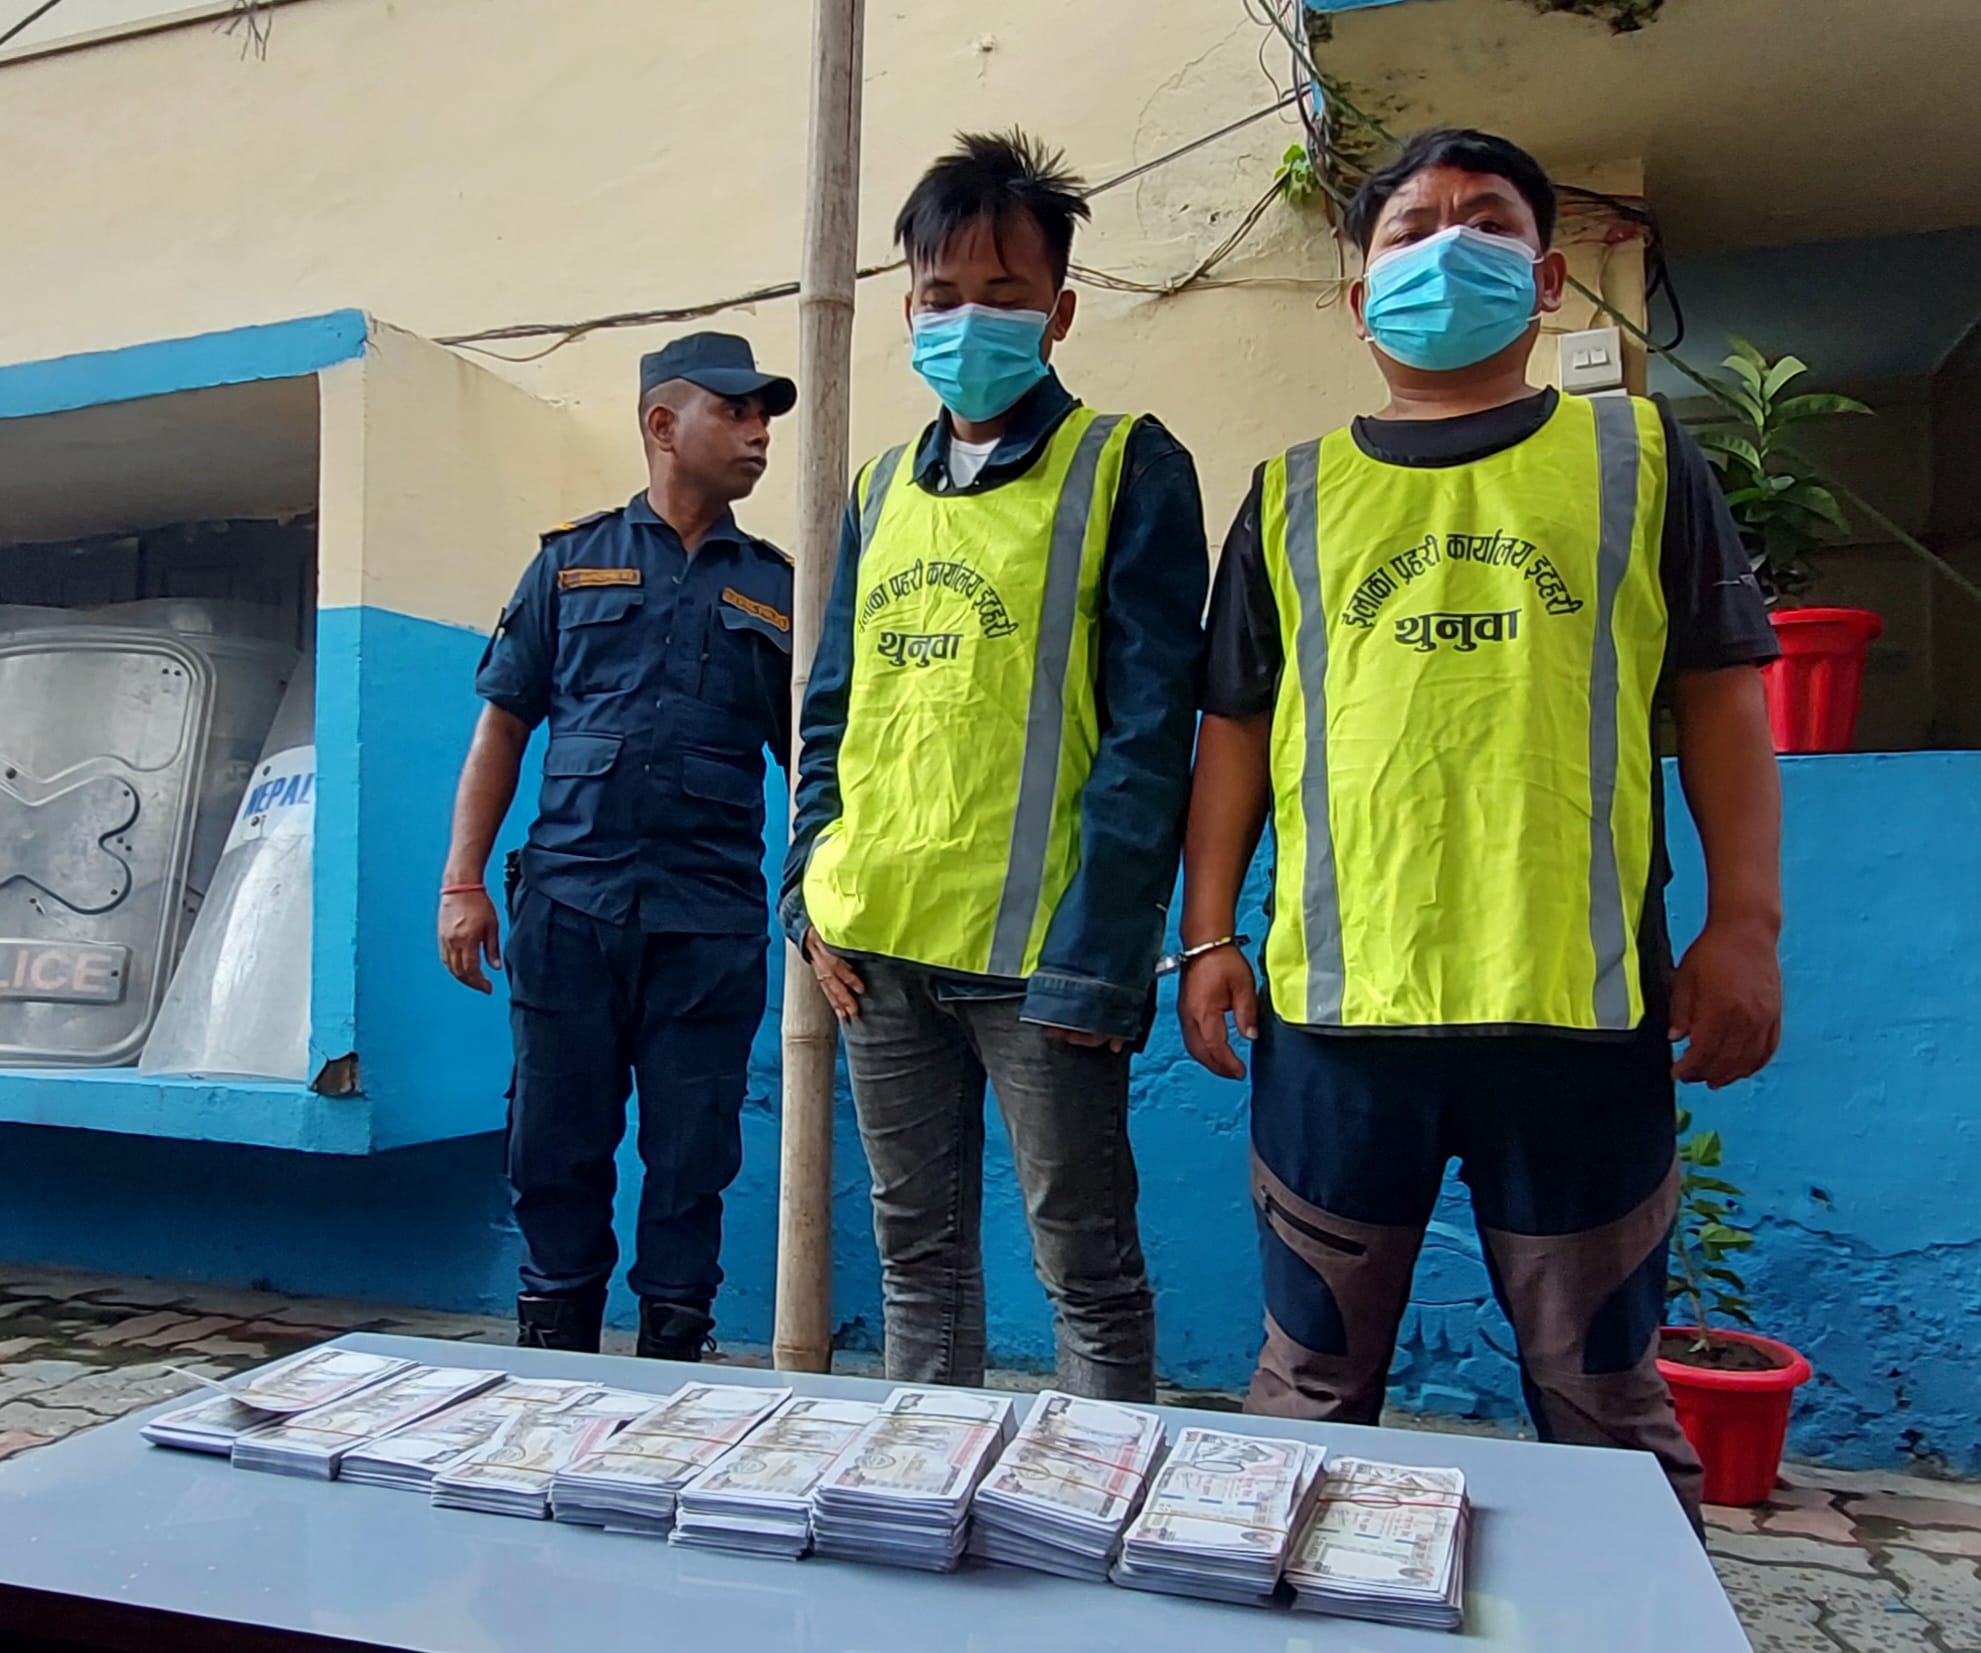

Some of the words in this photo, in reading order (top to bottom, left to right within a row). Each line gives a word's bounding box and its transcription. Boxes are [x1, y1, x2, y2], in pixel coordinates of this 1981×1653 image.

[888, 558, 924, 602] प्रहरी
[926, 558, 985, 600] कार्यालय
[970, 585, 1019, 639] इटहरी
[1341, 566, 1399, 629] इलाका
[1389, 534, 1440, 585] प्रहरी
[1446, 528, 1537, 569] कार्यालय
[1523, 554, 1584, 616] इटहरी
[877, 631, 964, 668] थुनुवा
[1394, 608, 1523, 652] थुनुवा
[242, 772, 314, 820] NEPAL
